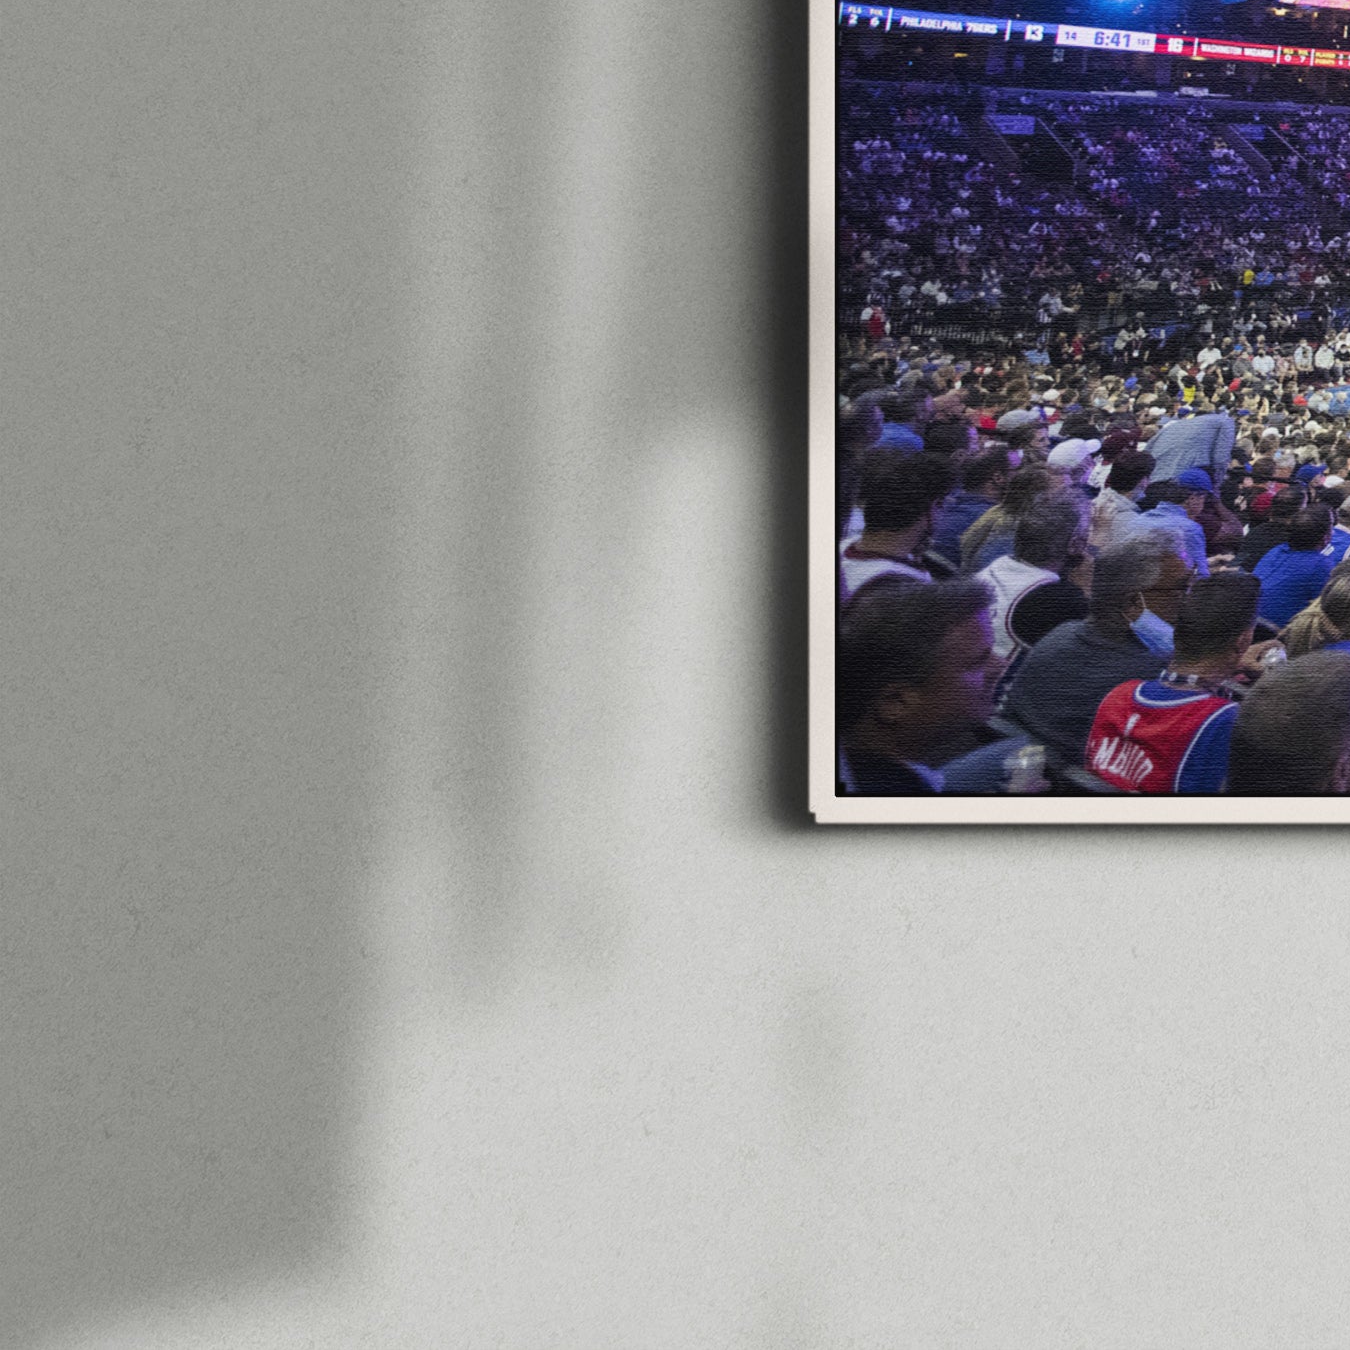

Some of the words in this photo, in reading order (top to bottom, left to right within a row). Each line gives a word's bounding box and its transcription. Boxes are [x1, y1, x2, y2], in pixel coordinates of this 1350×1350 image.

[900, 15, 963, 32] PHILADELPHIA
[966, 22, 998, 35] 76ERS
[1024, 24, 1045, 42] 13
[1064, 31, 1077, 41] 14
[1093, 30, 1132, 48] 6:41
